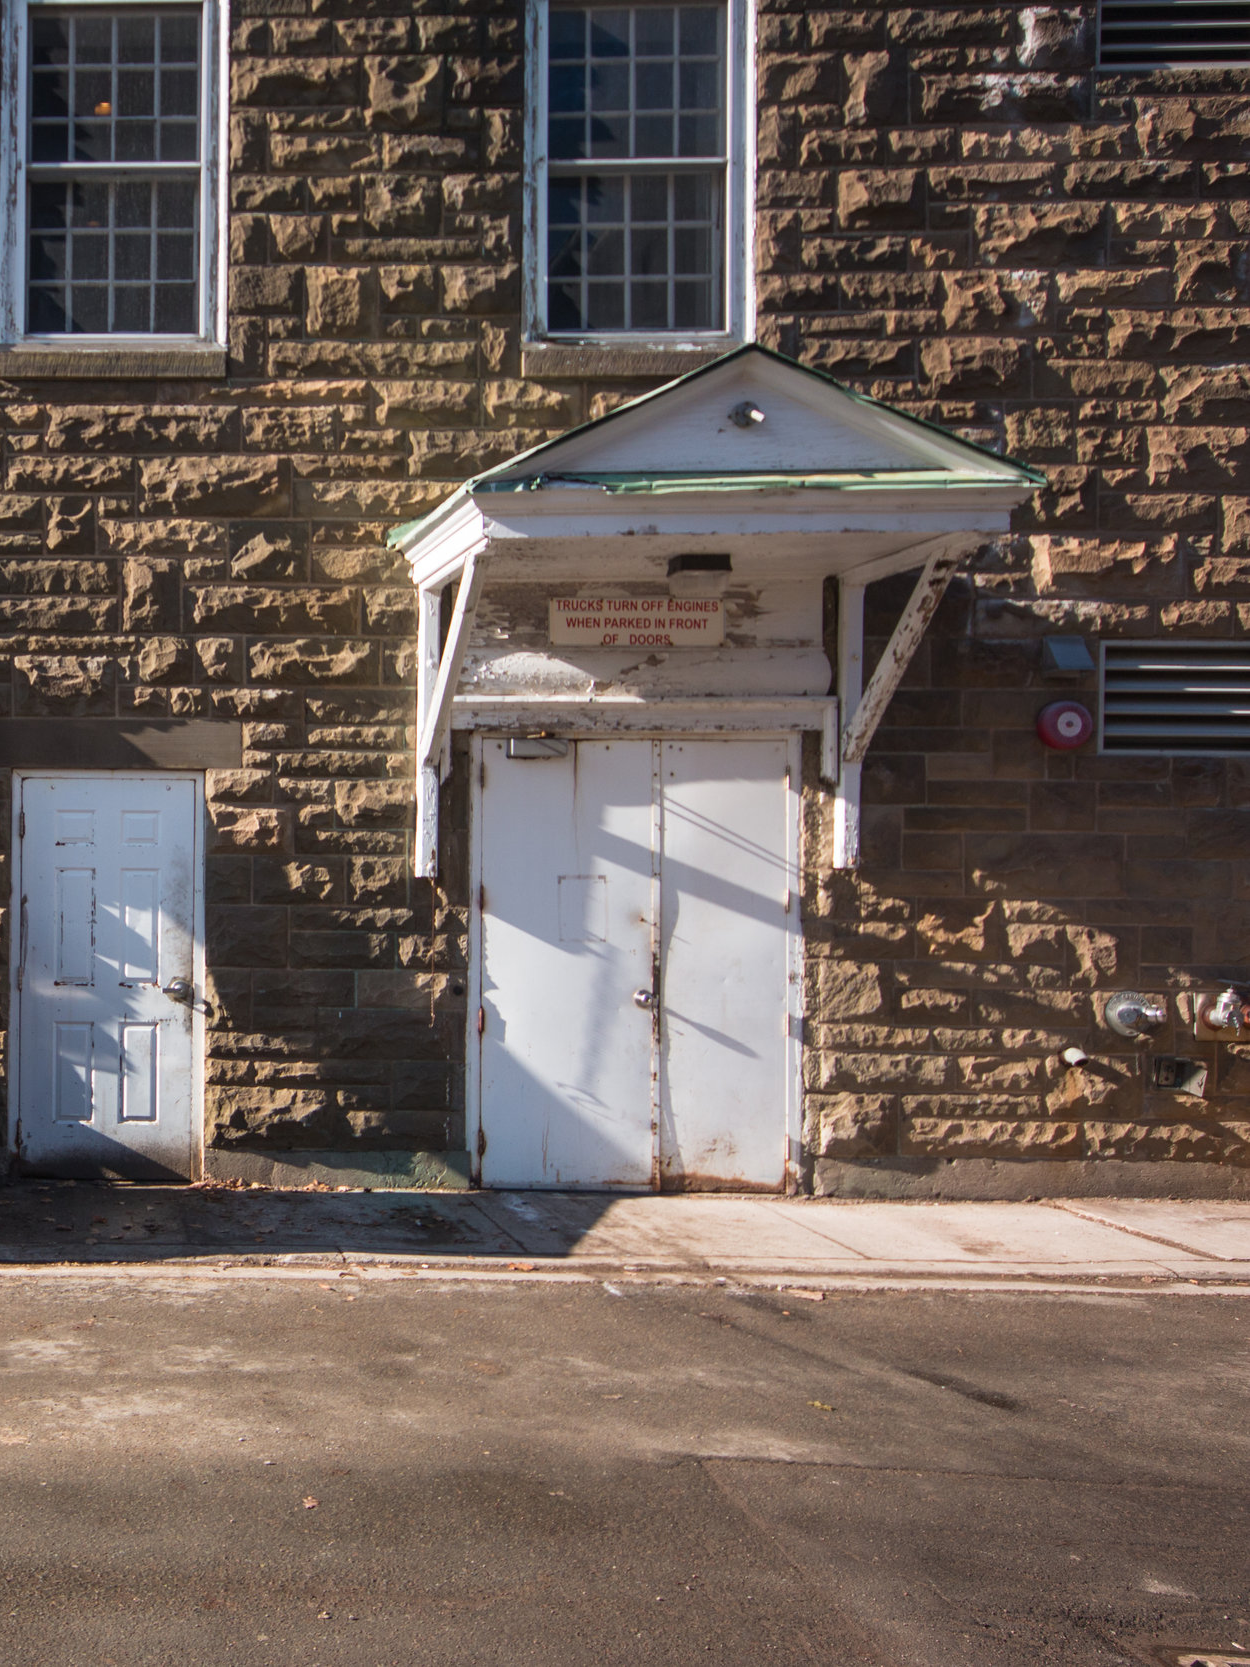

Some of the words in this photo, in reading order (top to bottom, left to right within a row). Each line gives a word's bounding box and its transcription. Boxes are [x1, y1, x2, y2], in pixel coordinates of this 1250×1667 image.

[556, 599, 603, 612] TRUCKS
[607, 600, 638, 612] TURN
[641, 600, 664, 612] OFF
[667, 600, 719, 612] ENGINES
[566, 617, 601, 629] WHEN
[604, 617, 652, 629] PARKED
[654, 618, 666, 629] IN
[669, 618, 708, 630] FRONT
[603, 634, 619, 645] OF
[629, 634, 671, 645] DOORS
